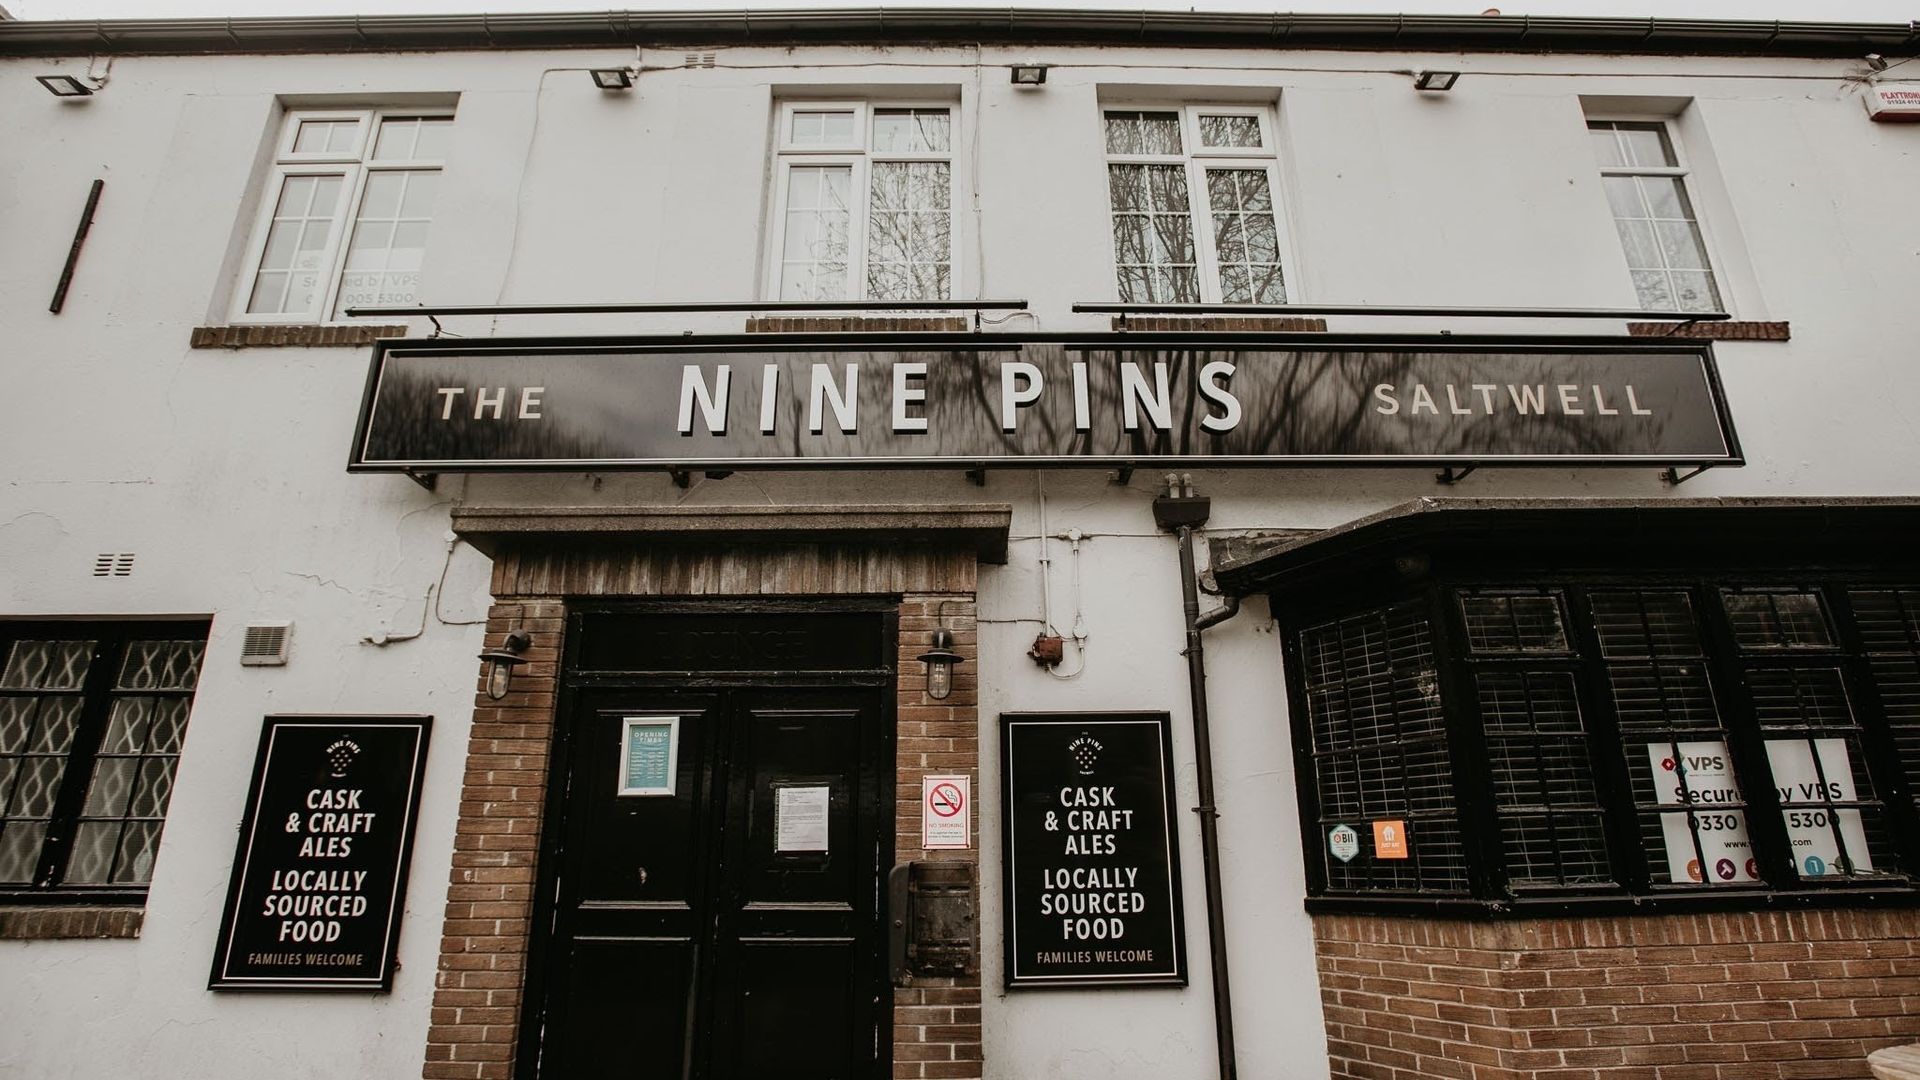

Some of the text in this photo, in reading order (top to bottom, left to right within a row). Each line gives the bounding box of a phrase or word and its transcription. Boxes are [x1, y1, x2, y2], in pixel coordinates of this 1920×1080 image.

[377, 293, 415, 305] 5300
[437, 361, 1652, 434] THE NINE PINS SALTWELL
[345, 740, 361, 753] PINS
[1069, 737, 1103, 751] NINE PINS
[1687, 756, 1724, 772] VPS
[306, 788, 363, 810] CASK
[1060, 786, 1116, 807] CASK
[285, 811, 376, 833] & CRAFT
[1044, 810, 1133, 831] & CRAFT
[299, 836, 353, 858] ALES
[1064, 834, 1116, 855] ALES
[271, 869, 368, 892] LOCALLY
[1044, 867, 1138, 890] LOCALLY
[262, 894, 368, 917] SOURCED
[1040, 892, 1145, 915] SOURCED
[279, 920, 341, 942] FOOD
[1063, 918, 1124, 940] FOOD
[248, 953, 364, 966] FAMILIES WELCOME
[1037, 949, 1154, 964] FAMILIES WELCOME
